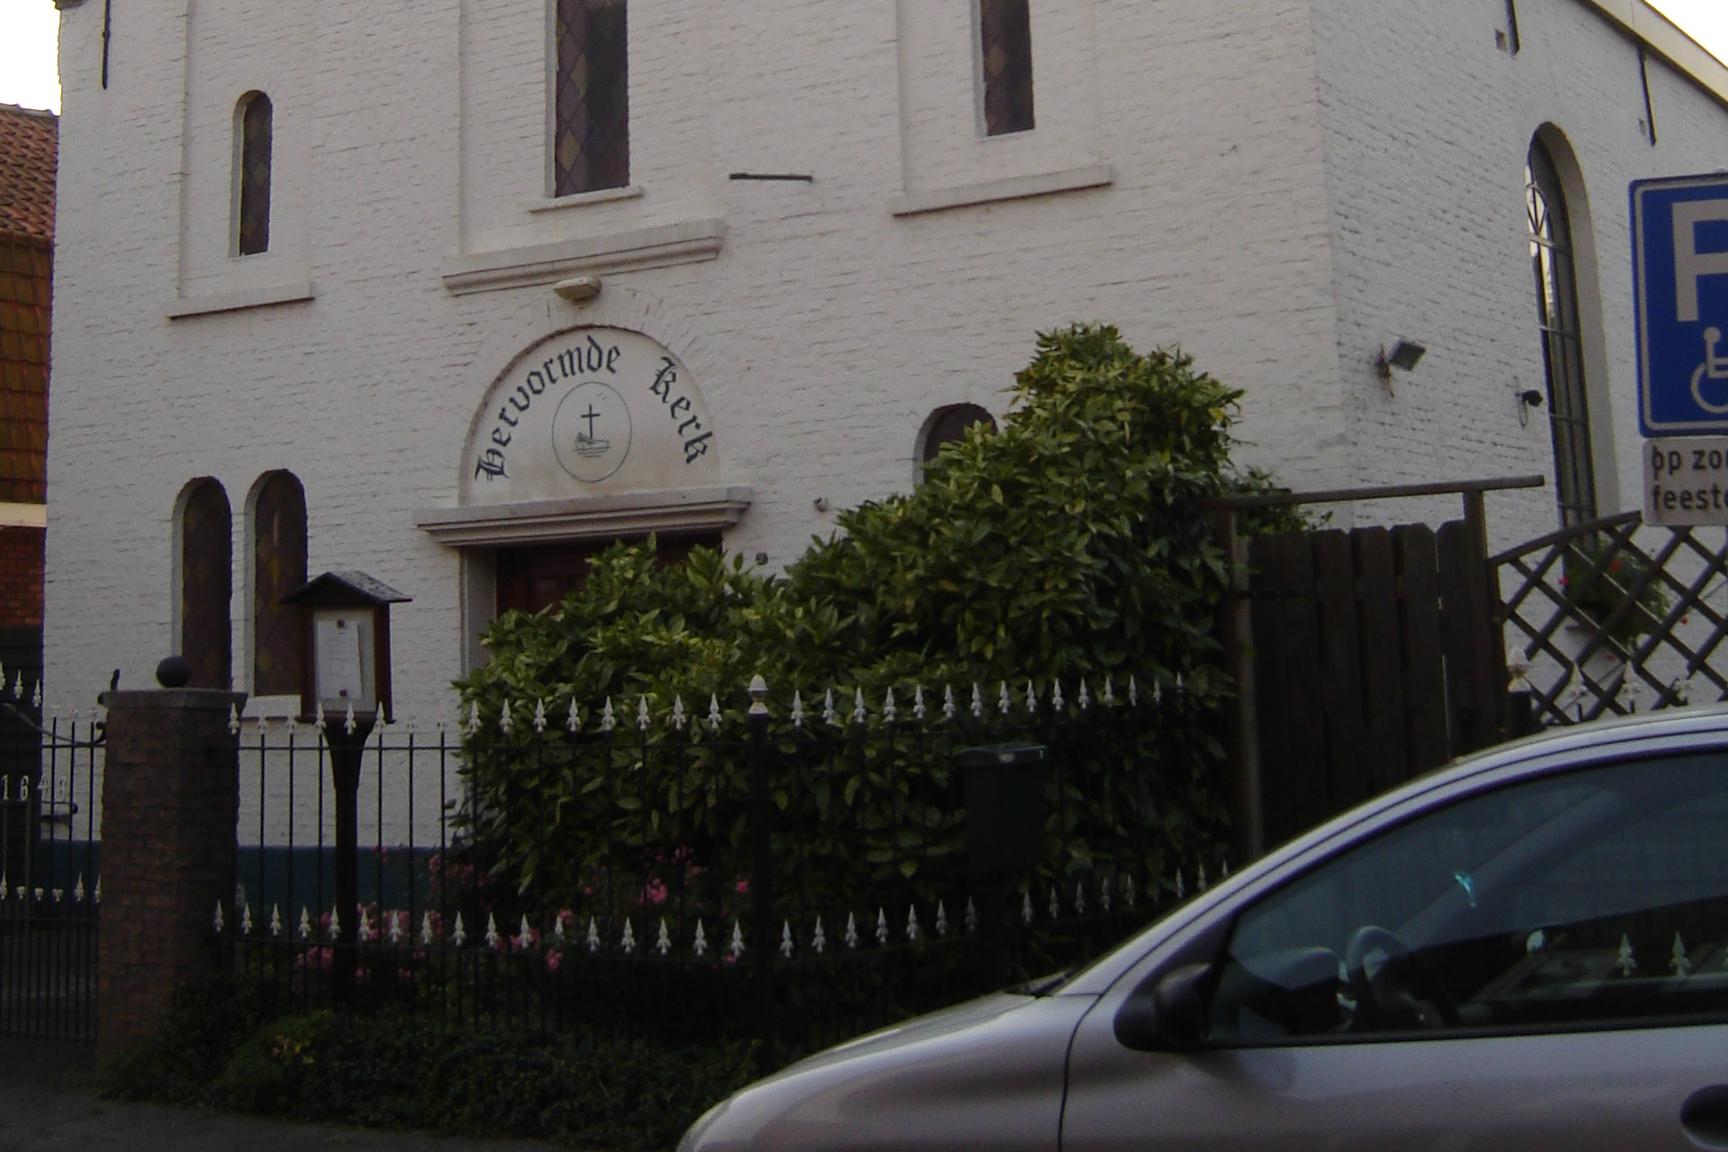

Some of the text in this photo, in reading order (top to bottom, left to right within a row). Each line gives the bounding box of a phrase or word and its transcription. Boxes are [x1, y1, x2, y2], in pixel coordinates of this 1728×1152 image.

[1672, 201, 1728, 322] P
[474, 335, 713, 481] Hervormde Kerk
[1652, 483, 1728, 510] feest
[1692, 450, 1728, 470] zo
